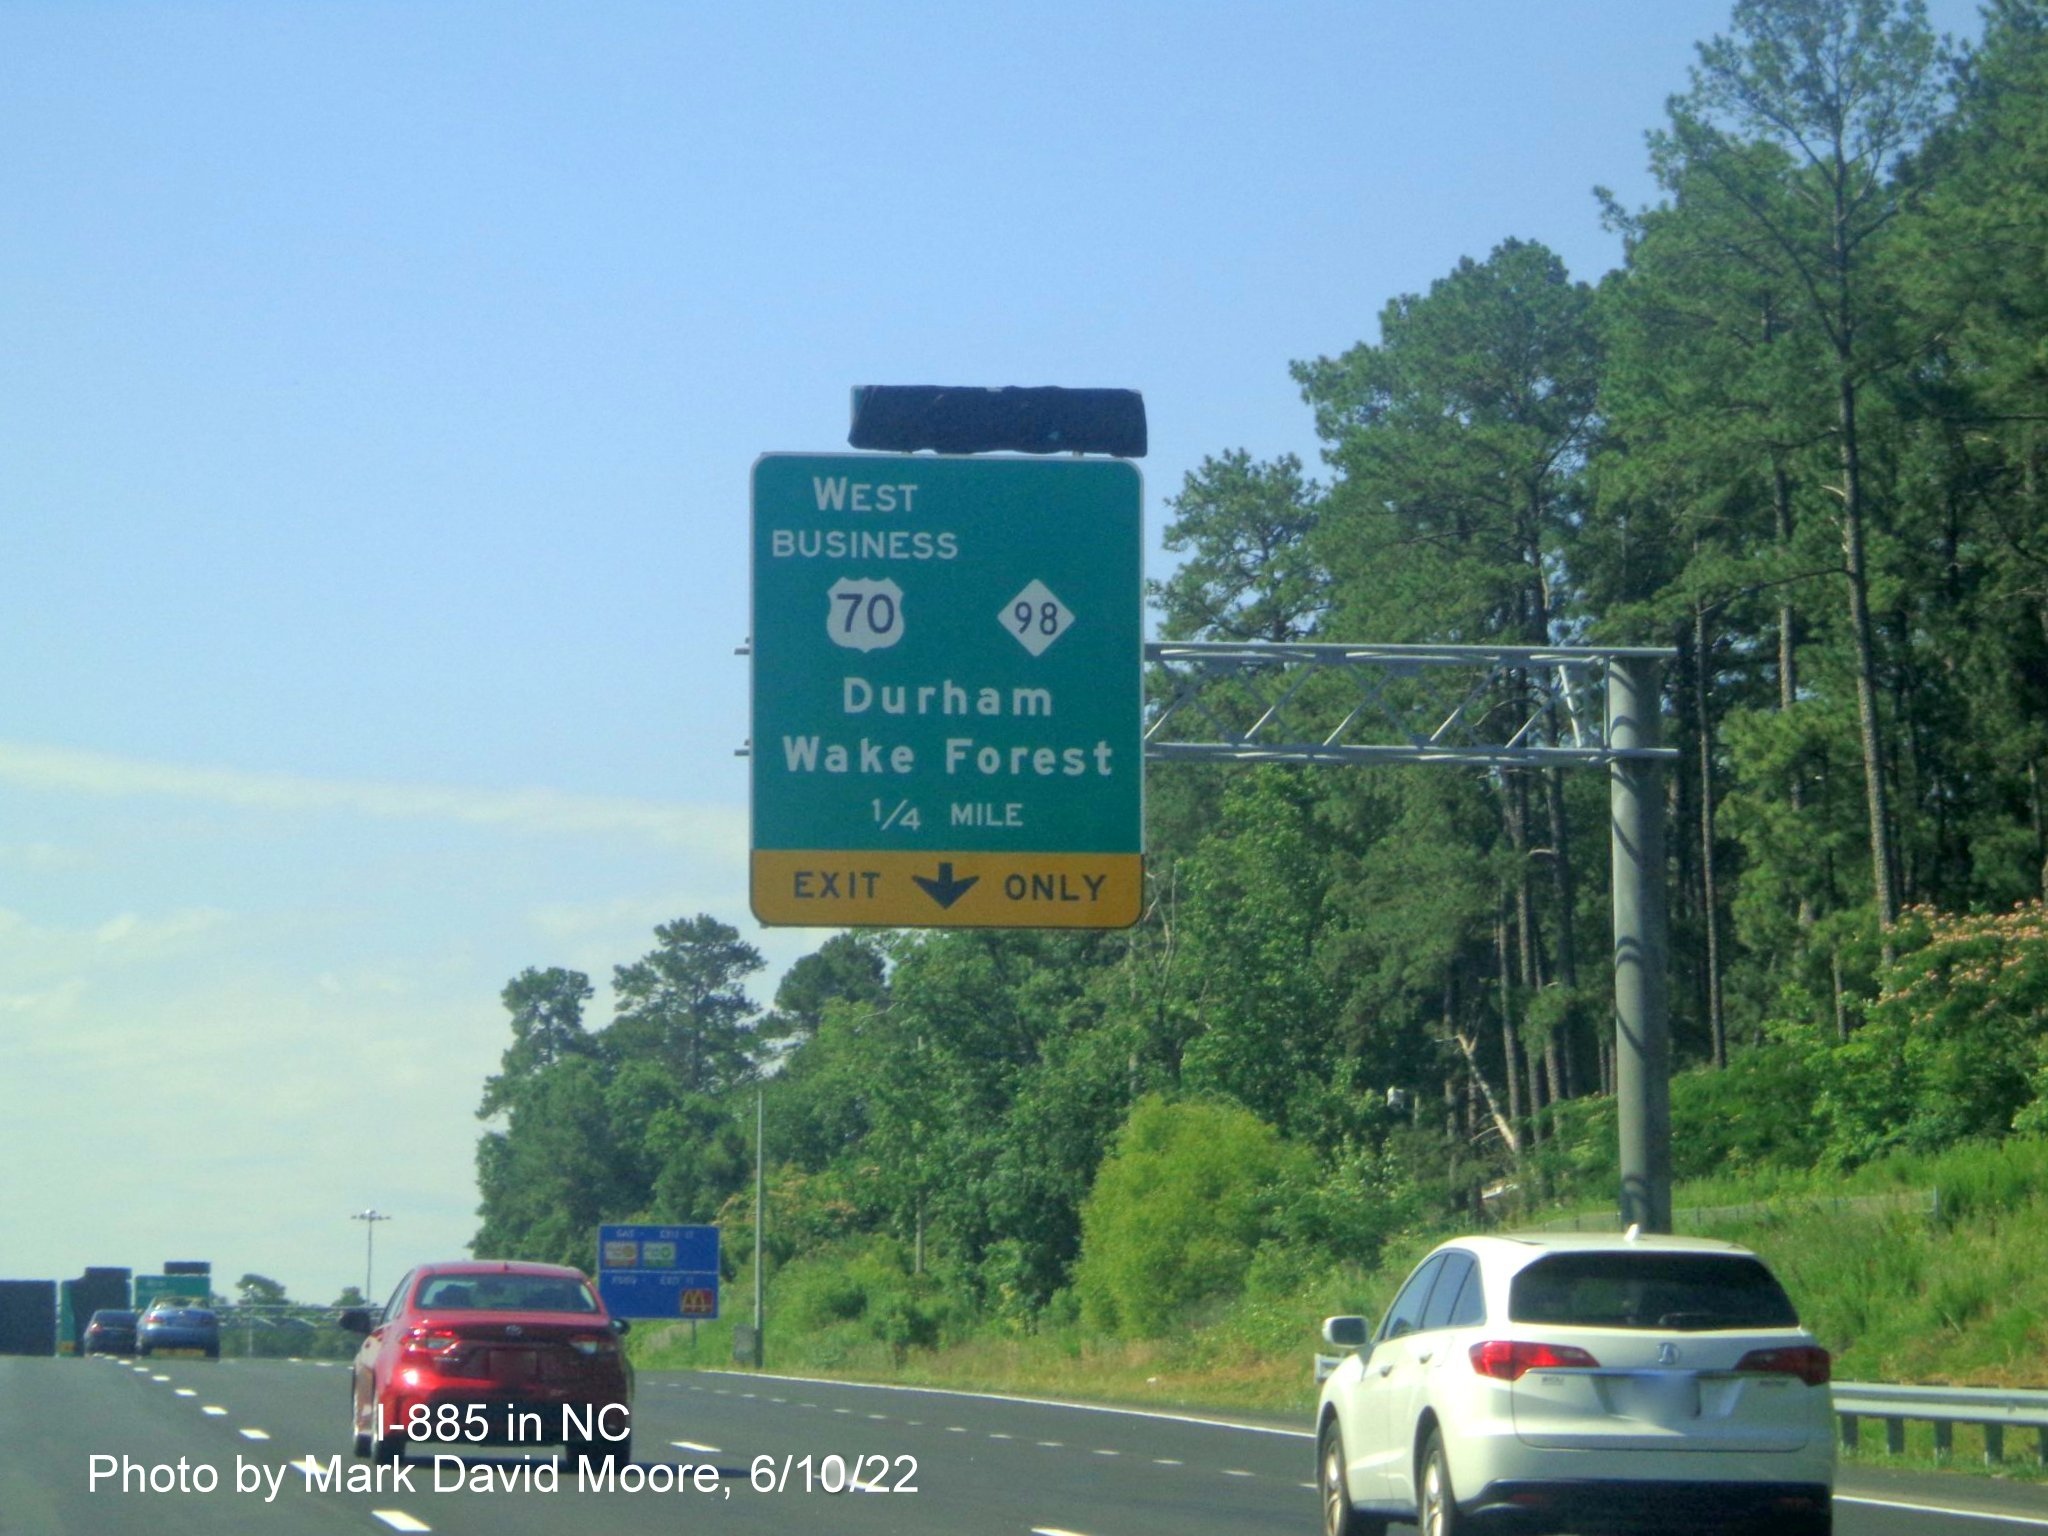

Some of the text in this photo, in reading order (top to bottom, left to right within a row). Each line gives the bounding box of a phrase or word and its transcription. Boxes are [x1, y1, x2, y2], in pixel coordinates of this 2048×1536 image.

[813, 476, 919, 512] WEST
[771, 529, 959, 560] BUSINESS
[835, 592, 896, 635] 70
[1014, 600, 1059, 636] 98
[843, 676, 1052, 716] Durham
[782, 735, 1113, 776] Wake Forest
[950, 803, 1024, 828] MILE
[793, 871, 1108, 902] EXIT ONLY
